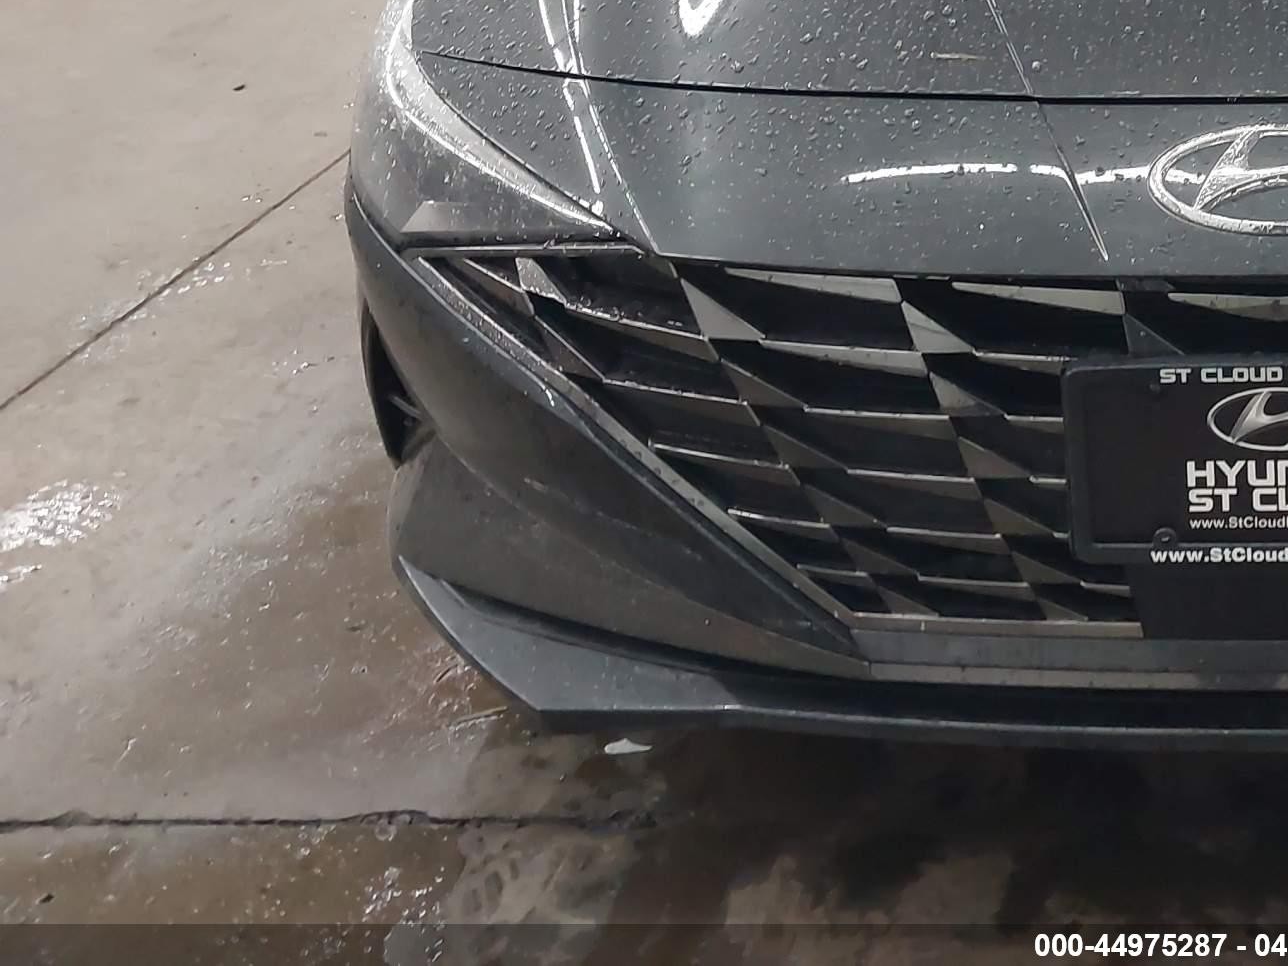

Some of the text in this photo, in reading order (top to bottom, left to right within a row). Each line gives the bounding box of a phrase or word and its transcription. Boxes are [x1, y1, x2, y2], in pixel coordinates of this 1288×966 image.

[1159, 367, 1192, 384] ST
[1200, 366, 1284, 383] CLOUD
[1188, 487, 1238, 513] ST
